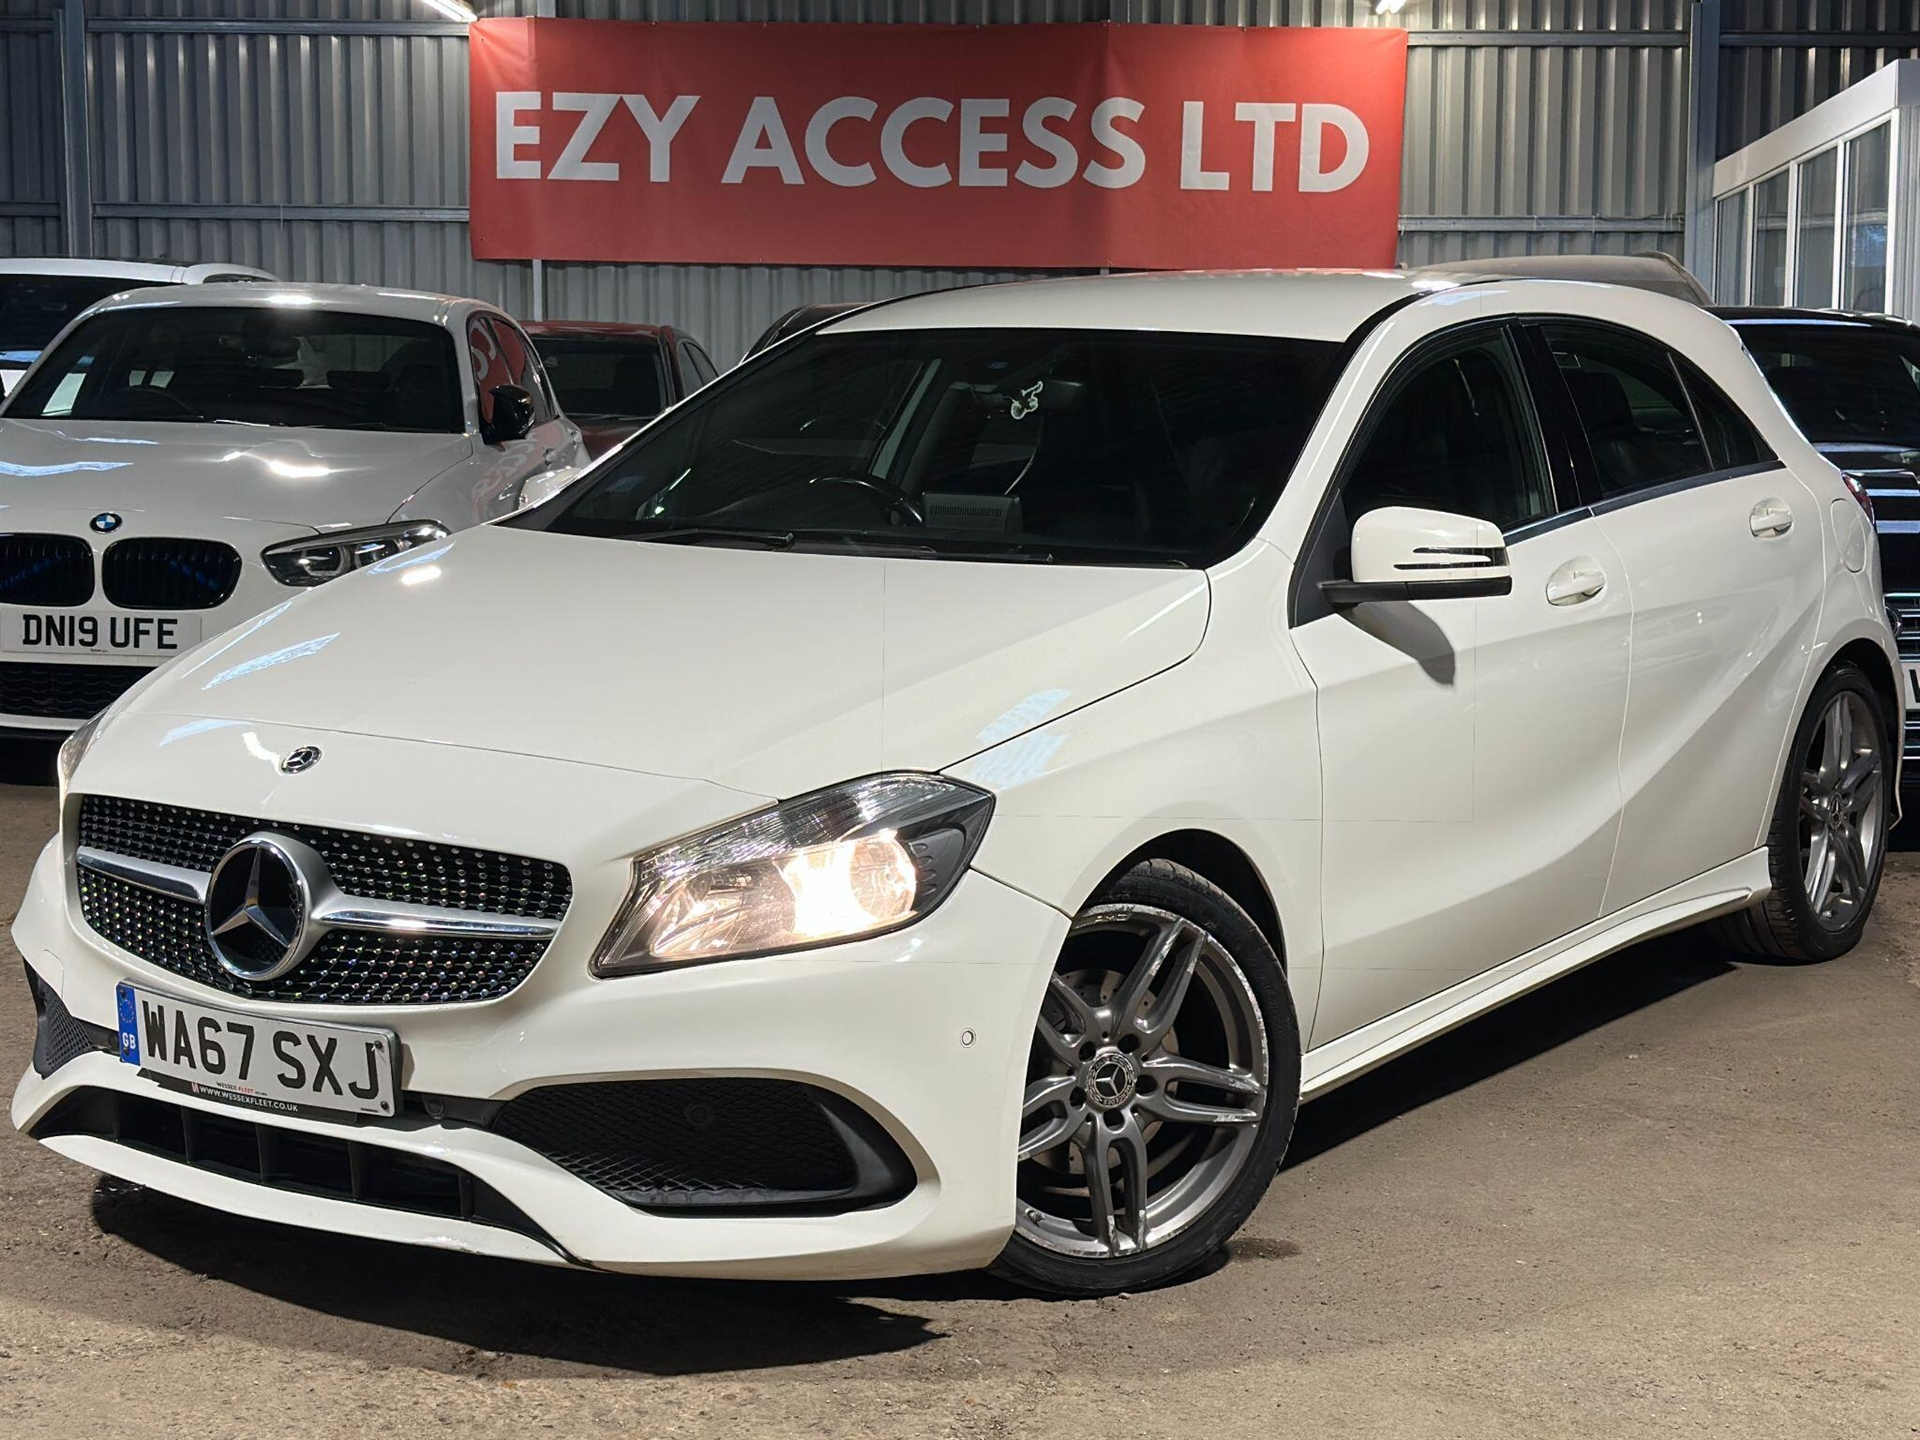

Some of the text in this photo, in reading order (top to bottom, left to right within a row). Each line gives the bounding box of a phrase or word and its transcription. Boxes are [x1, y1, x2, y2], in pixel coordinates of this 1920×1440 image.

[496, 91, 1370, 193] EZY ACCESS LTD
[22, 614, 178, 649] DN19 UFE
[122, 1032, 136, 1050] GB
[142, 1000, 379, 1100] WA67 SXJ
[200, 1086, 299, 1112] WWW.WESSEXFLEET.CO.UK
